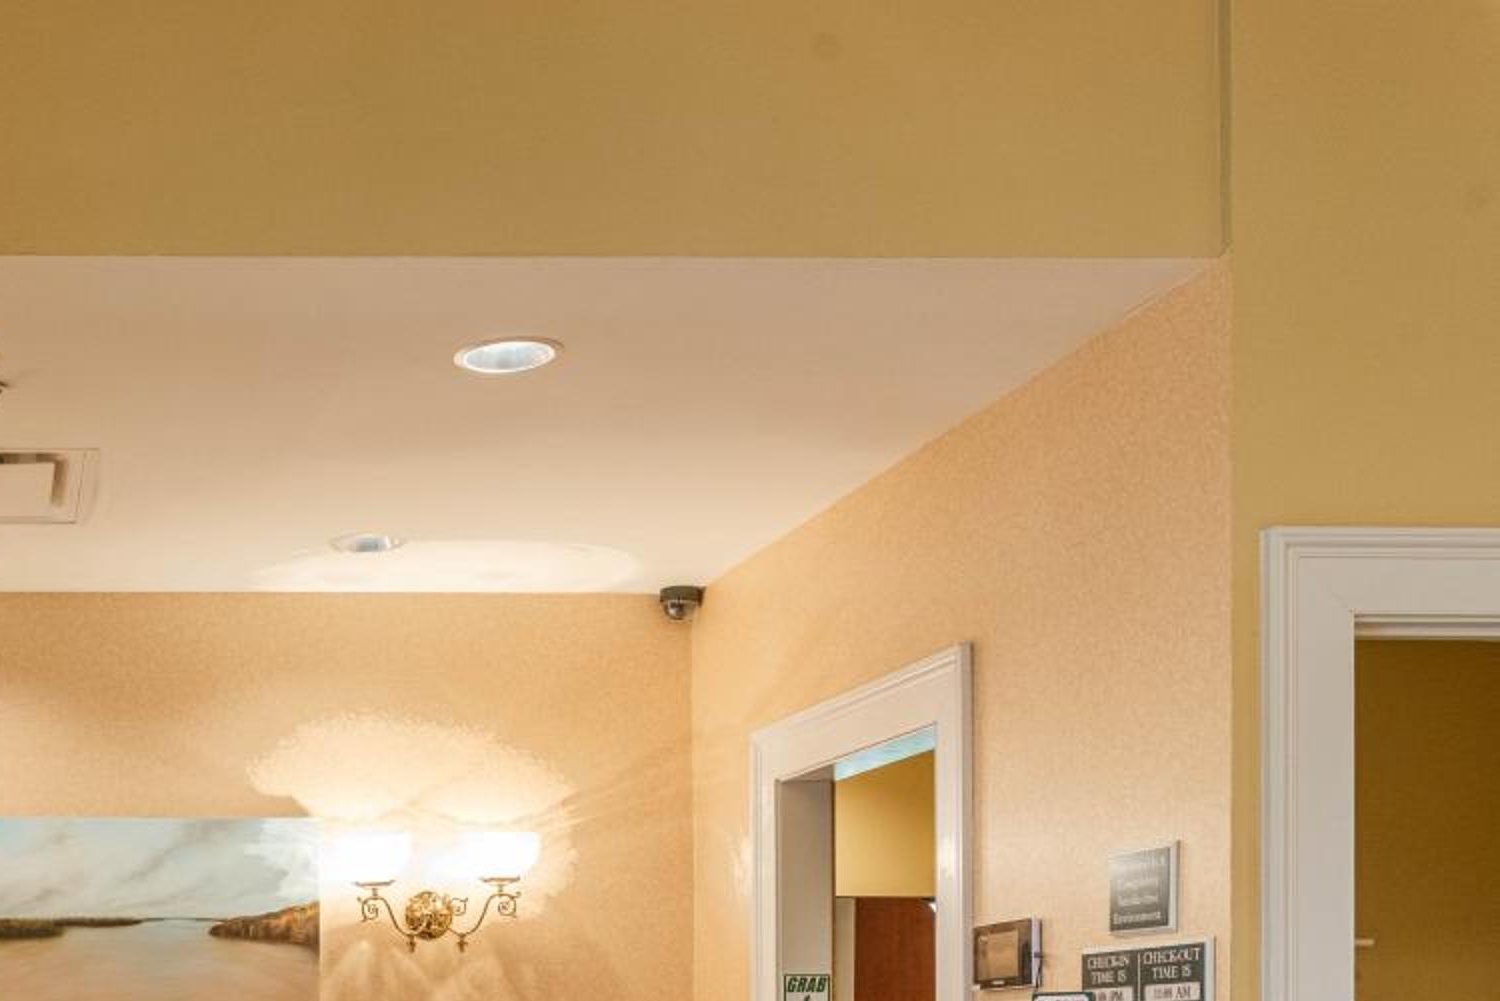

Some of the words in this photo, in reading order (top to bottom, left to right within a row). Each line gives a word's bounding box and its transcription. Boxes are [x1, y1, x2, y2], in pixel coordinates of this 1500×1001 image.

[1142, 947, 1202, 965] CHECK-OUT
[1092, 971, 1116, 984] TIME
[1152, 966, 1179, 980] TIME
[1181, 963, 1192, 977] IS
[787, 977, 827, 992] GRAB
[1175, 985, 1192, 999] AM
